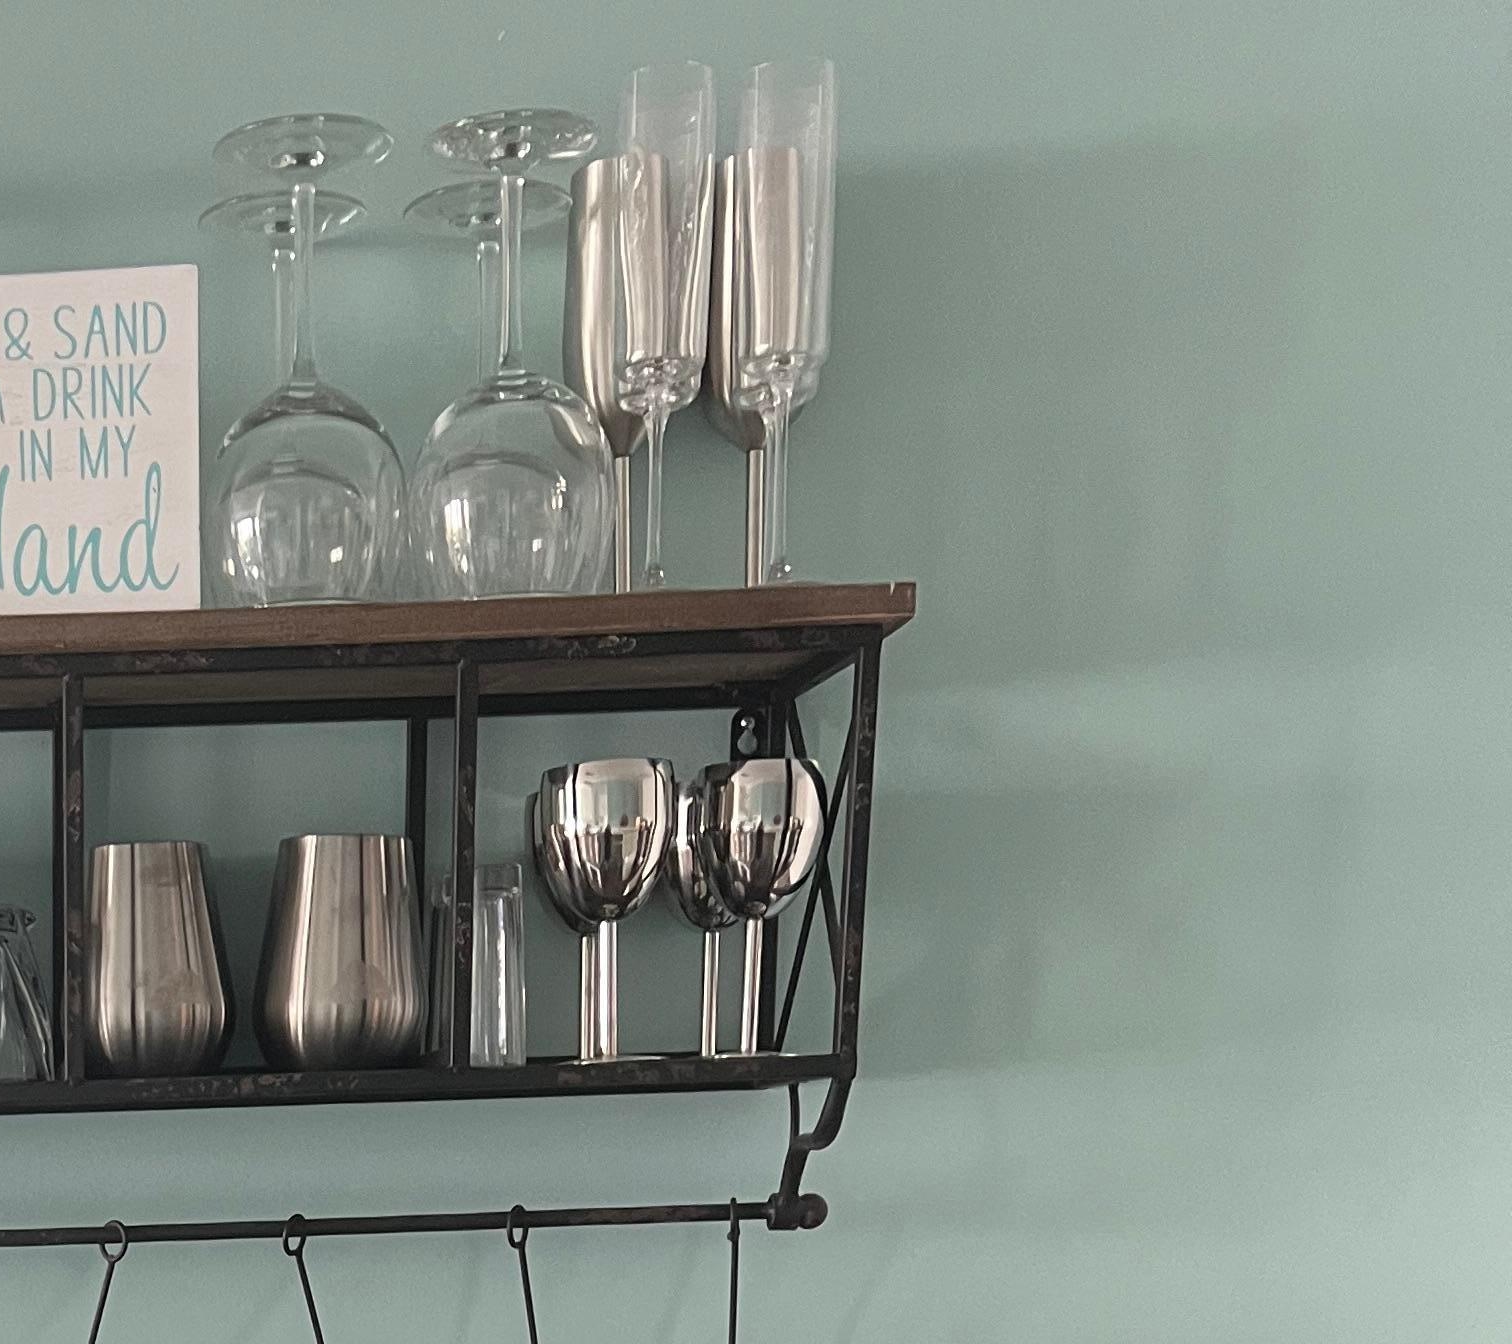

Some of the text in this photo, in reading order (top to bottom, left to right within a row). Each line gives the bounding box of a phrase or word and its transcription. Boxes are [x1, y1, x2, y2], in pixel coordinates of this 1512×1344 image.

[3, 307, 34, 361] &
[53, 301, 168, 361] SAND
[32, 363, 153, 422] DRINK
[19, 424, 137, 482] IN MY
